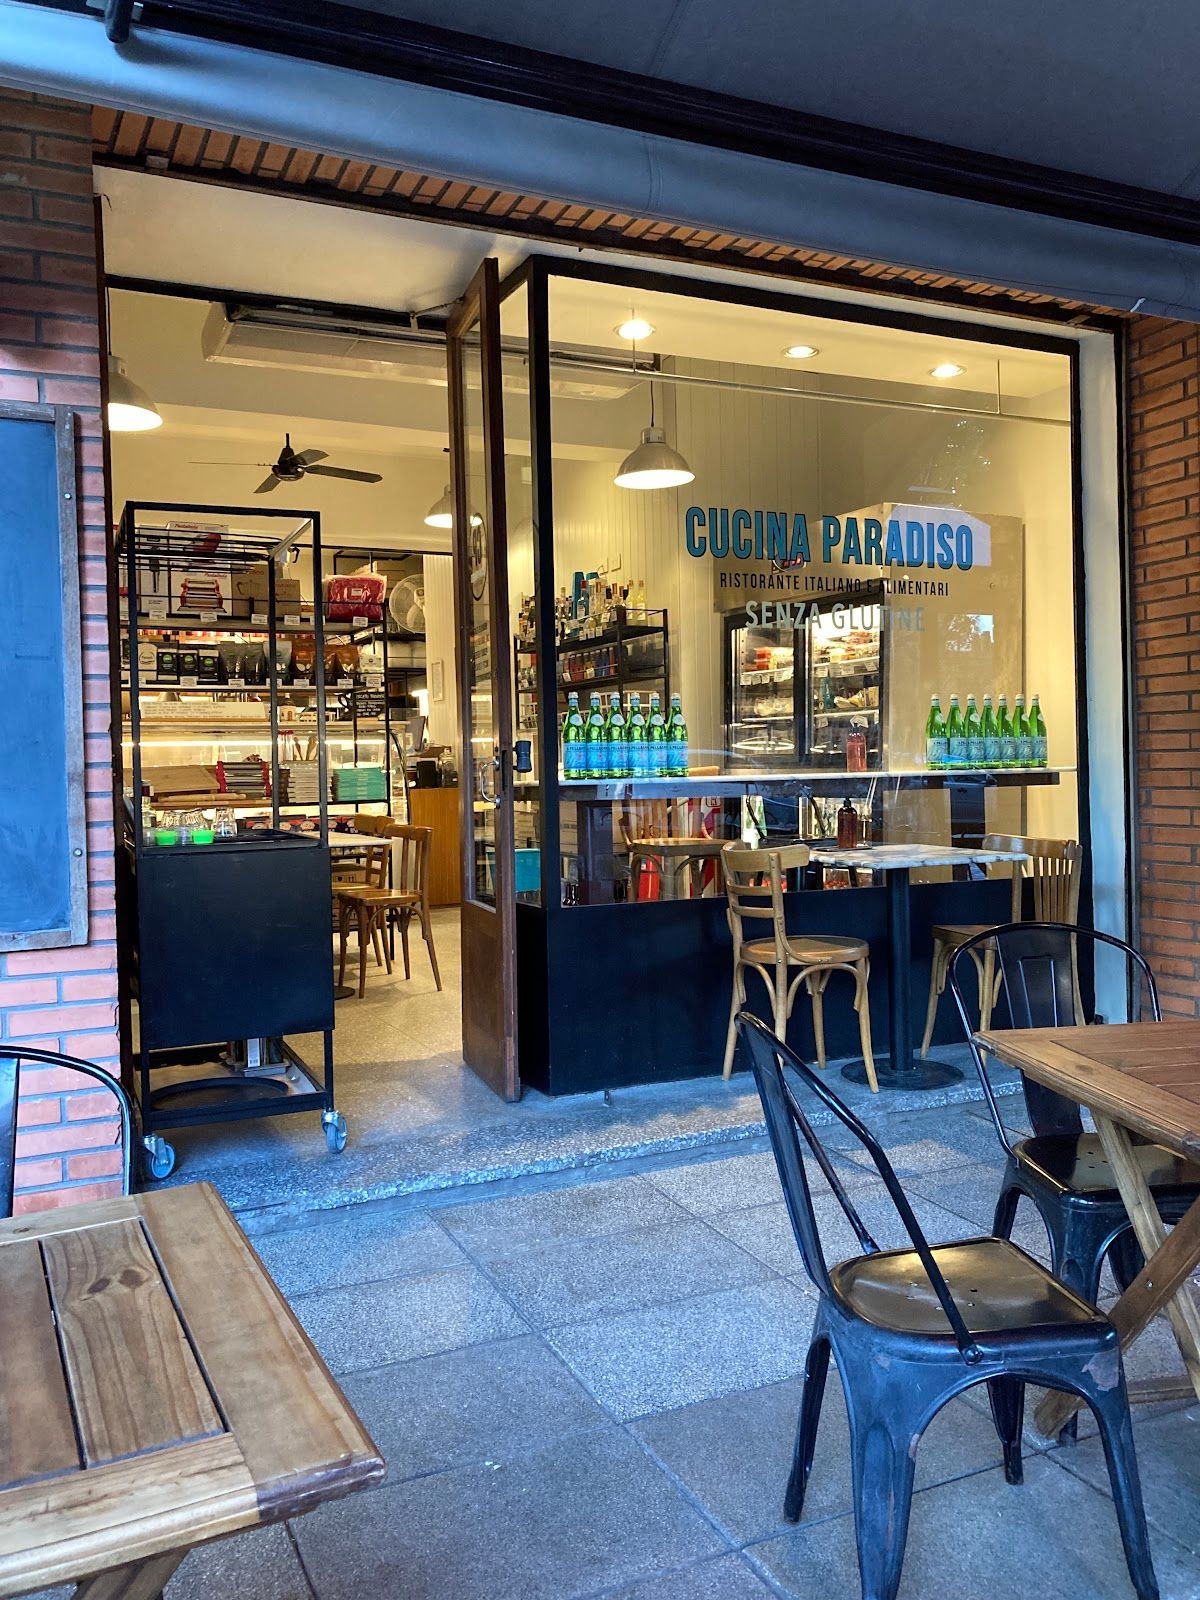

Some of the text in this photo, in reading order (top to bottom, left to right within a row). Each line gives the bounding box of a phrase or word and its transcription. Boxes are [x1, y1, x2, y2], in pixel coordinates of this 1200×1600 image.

[685, 506, 973, 571] CUCINA PARADISO
[720, 573, 949, 597] RISTORANTE ITALIANO E ALIMENTARI
[744, 600, 822, 630] SENZA
